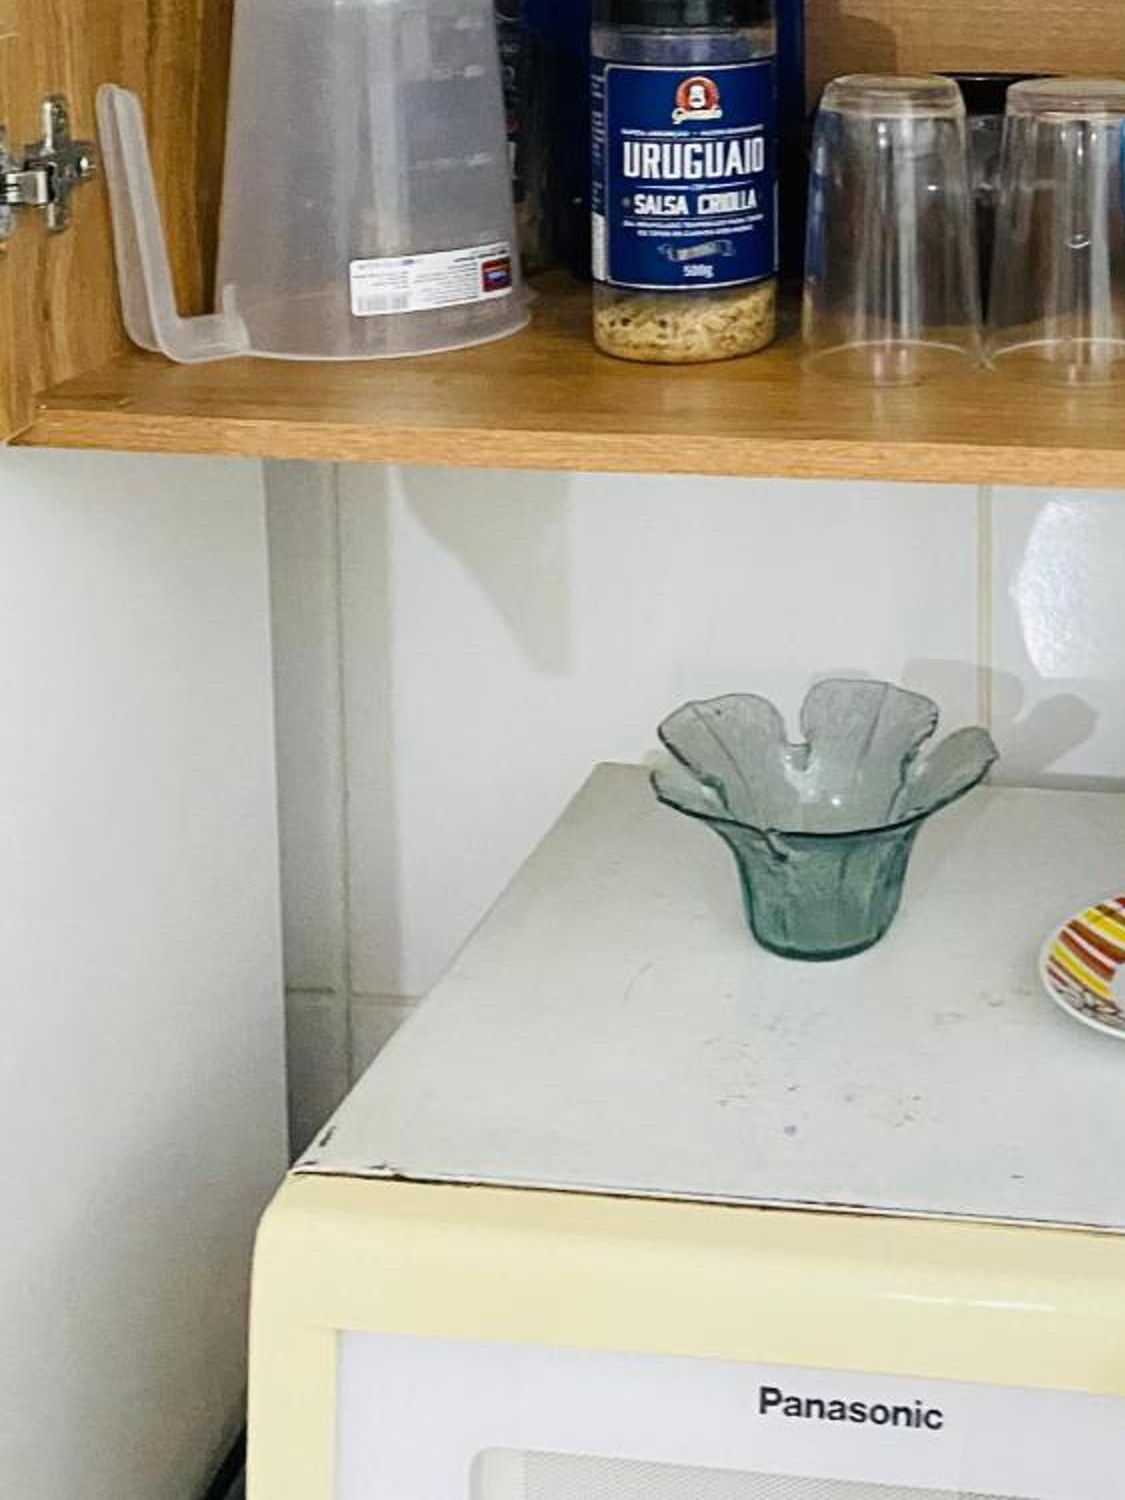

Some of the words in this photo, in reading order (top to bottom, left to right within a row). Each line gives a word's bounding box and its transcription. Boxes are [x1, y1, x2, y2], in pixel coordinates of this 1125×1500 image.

[623, 136, 765, 179] URUGUAIO
[634, 193, 689, 215] SALSA
[759, 1386, 943, 1430] Panasonic
